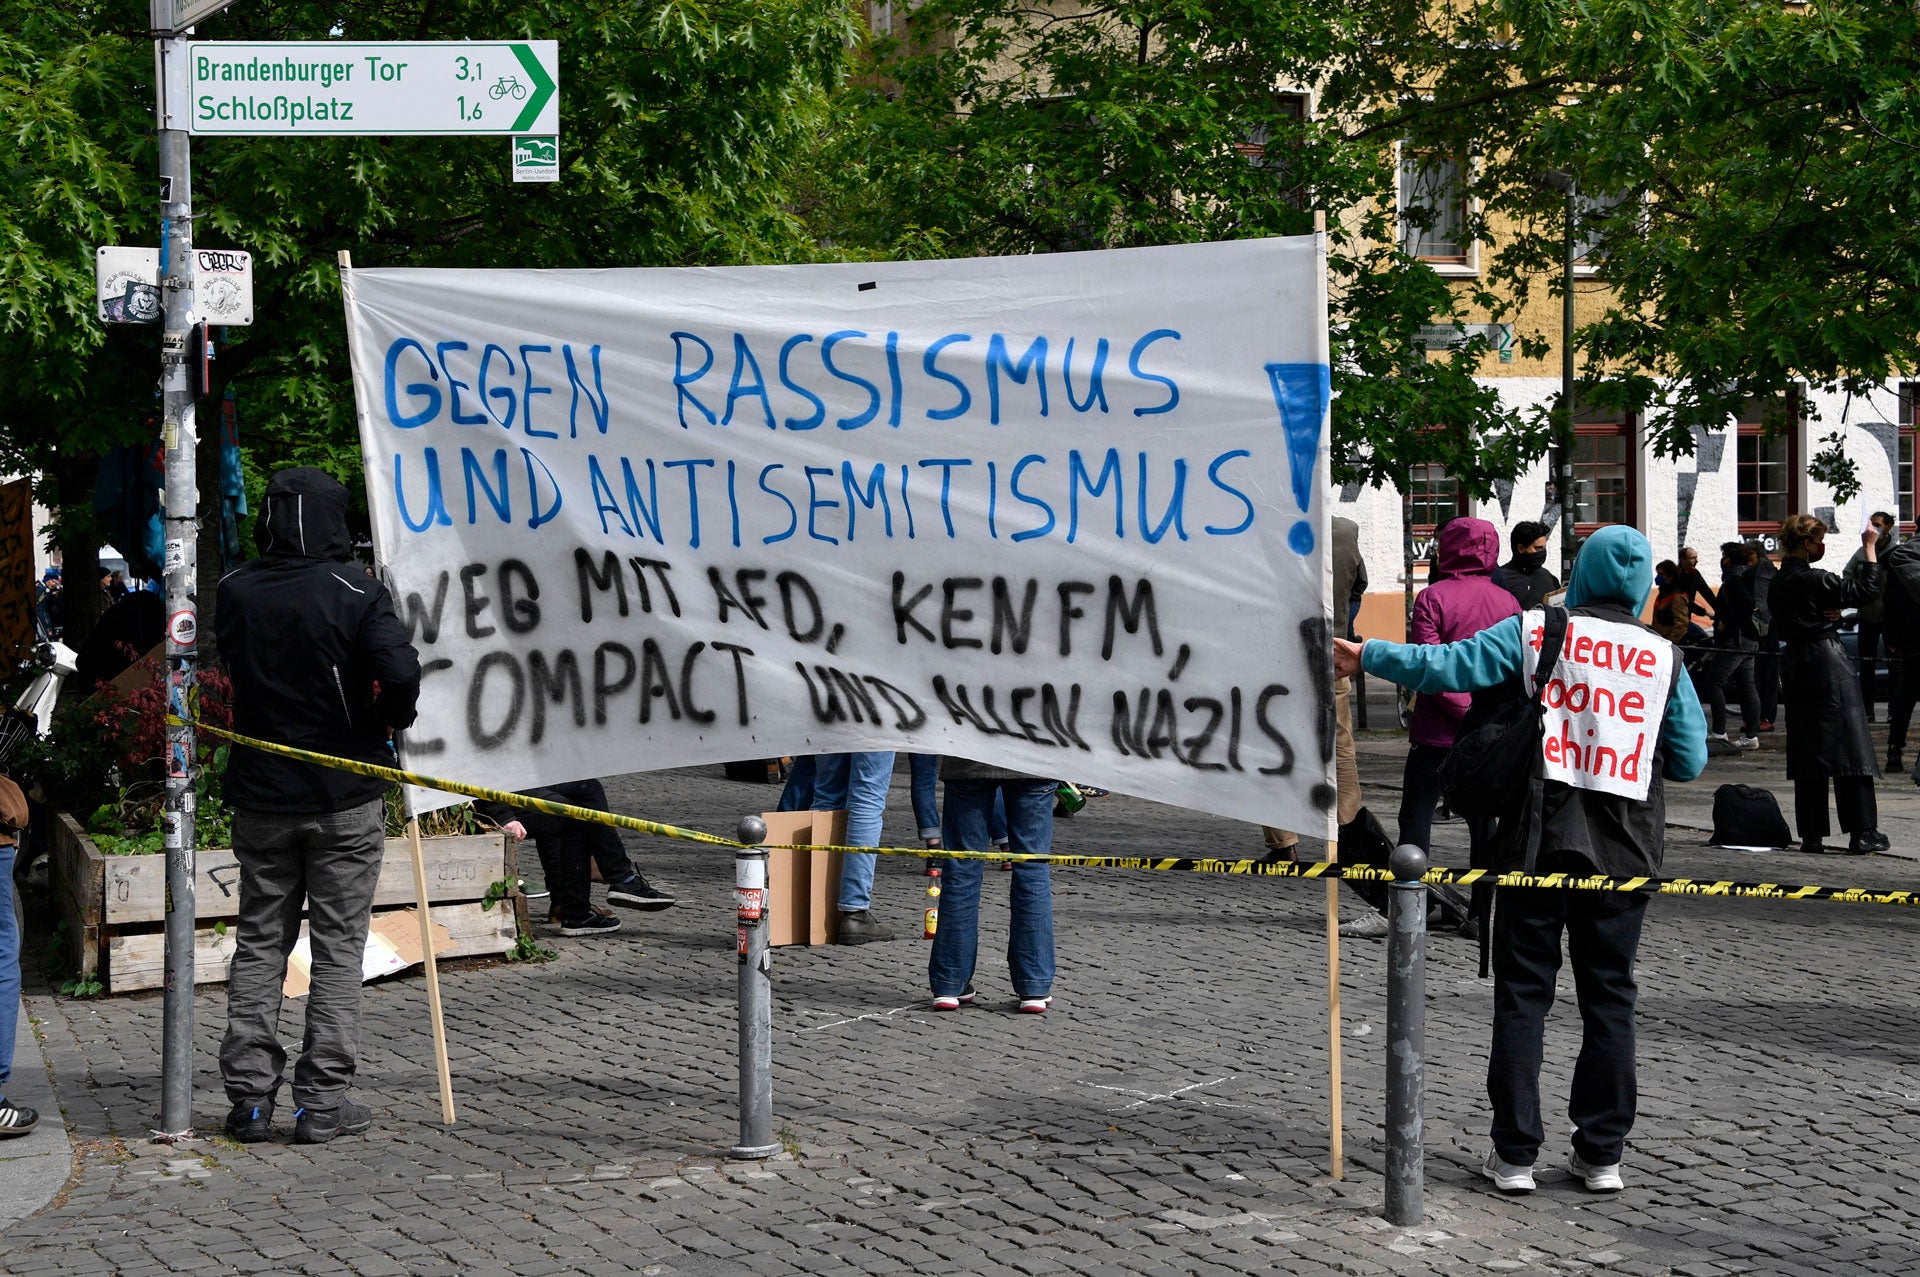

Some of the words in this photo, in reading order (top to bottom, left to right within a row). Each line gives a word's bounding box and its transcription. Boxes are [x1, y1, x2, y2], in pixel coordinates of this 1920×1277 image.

[197, 56, 354, 88] Brandenburger
[364, 56, 408, 81] Tor
[455, 56, 482, 82] 3,1
[198, 95, 354, 127] Schloßplatz
[457, 95, 483, 122] 1,6
[384, 337, 609, 440] GEGEN
[670, 328, 1183, 432] RASSISMUS
[394, 446, 564, 534] UND
[587, 447, 1256, 550] ANTISEMITISMUS
[400, 559, 541, 646] WEG
[574, 547, 682, 624] MIT
[402, 637, 756, 757] COMPACT
[794, 660, 929, 732] UND
[931, 674, 1093, 753] ALLEN
[1111, 684, 1295, 777] NAZIS
